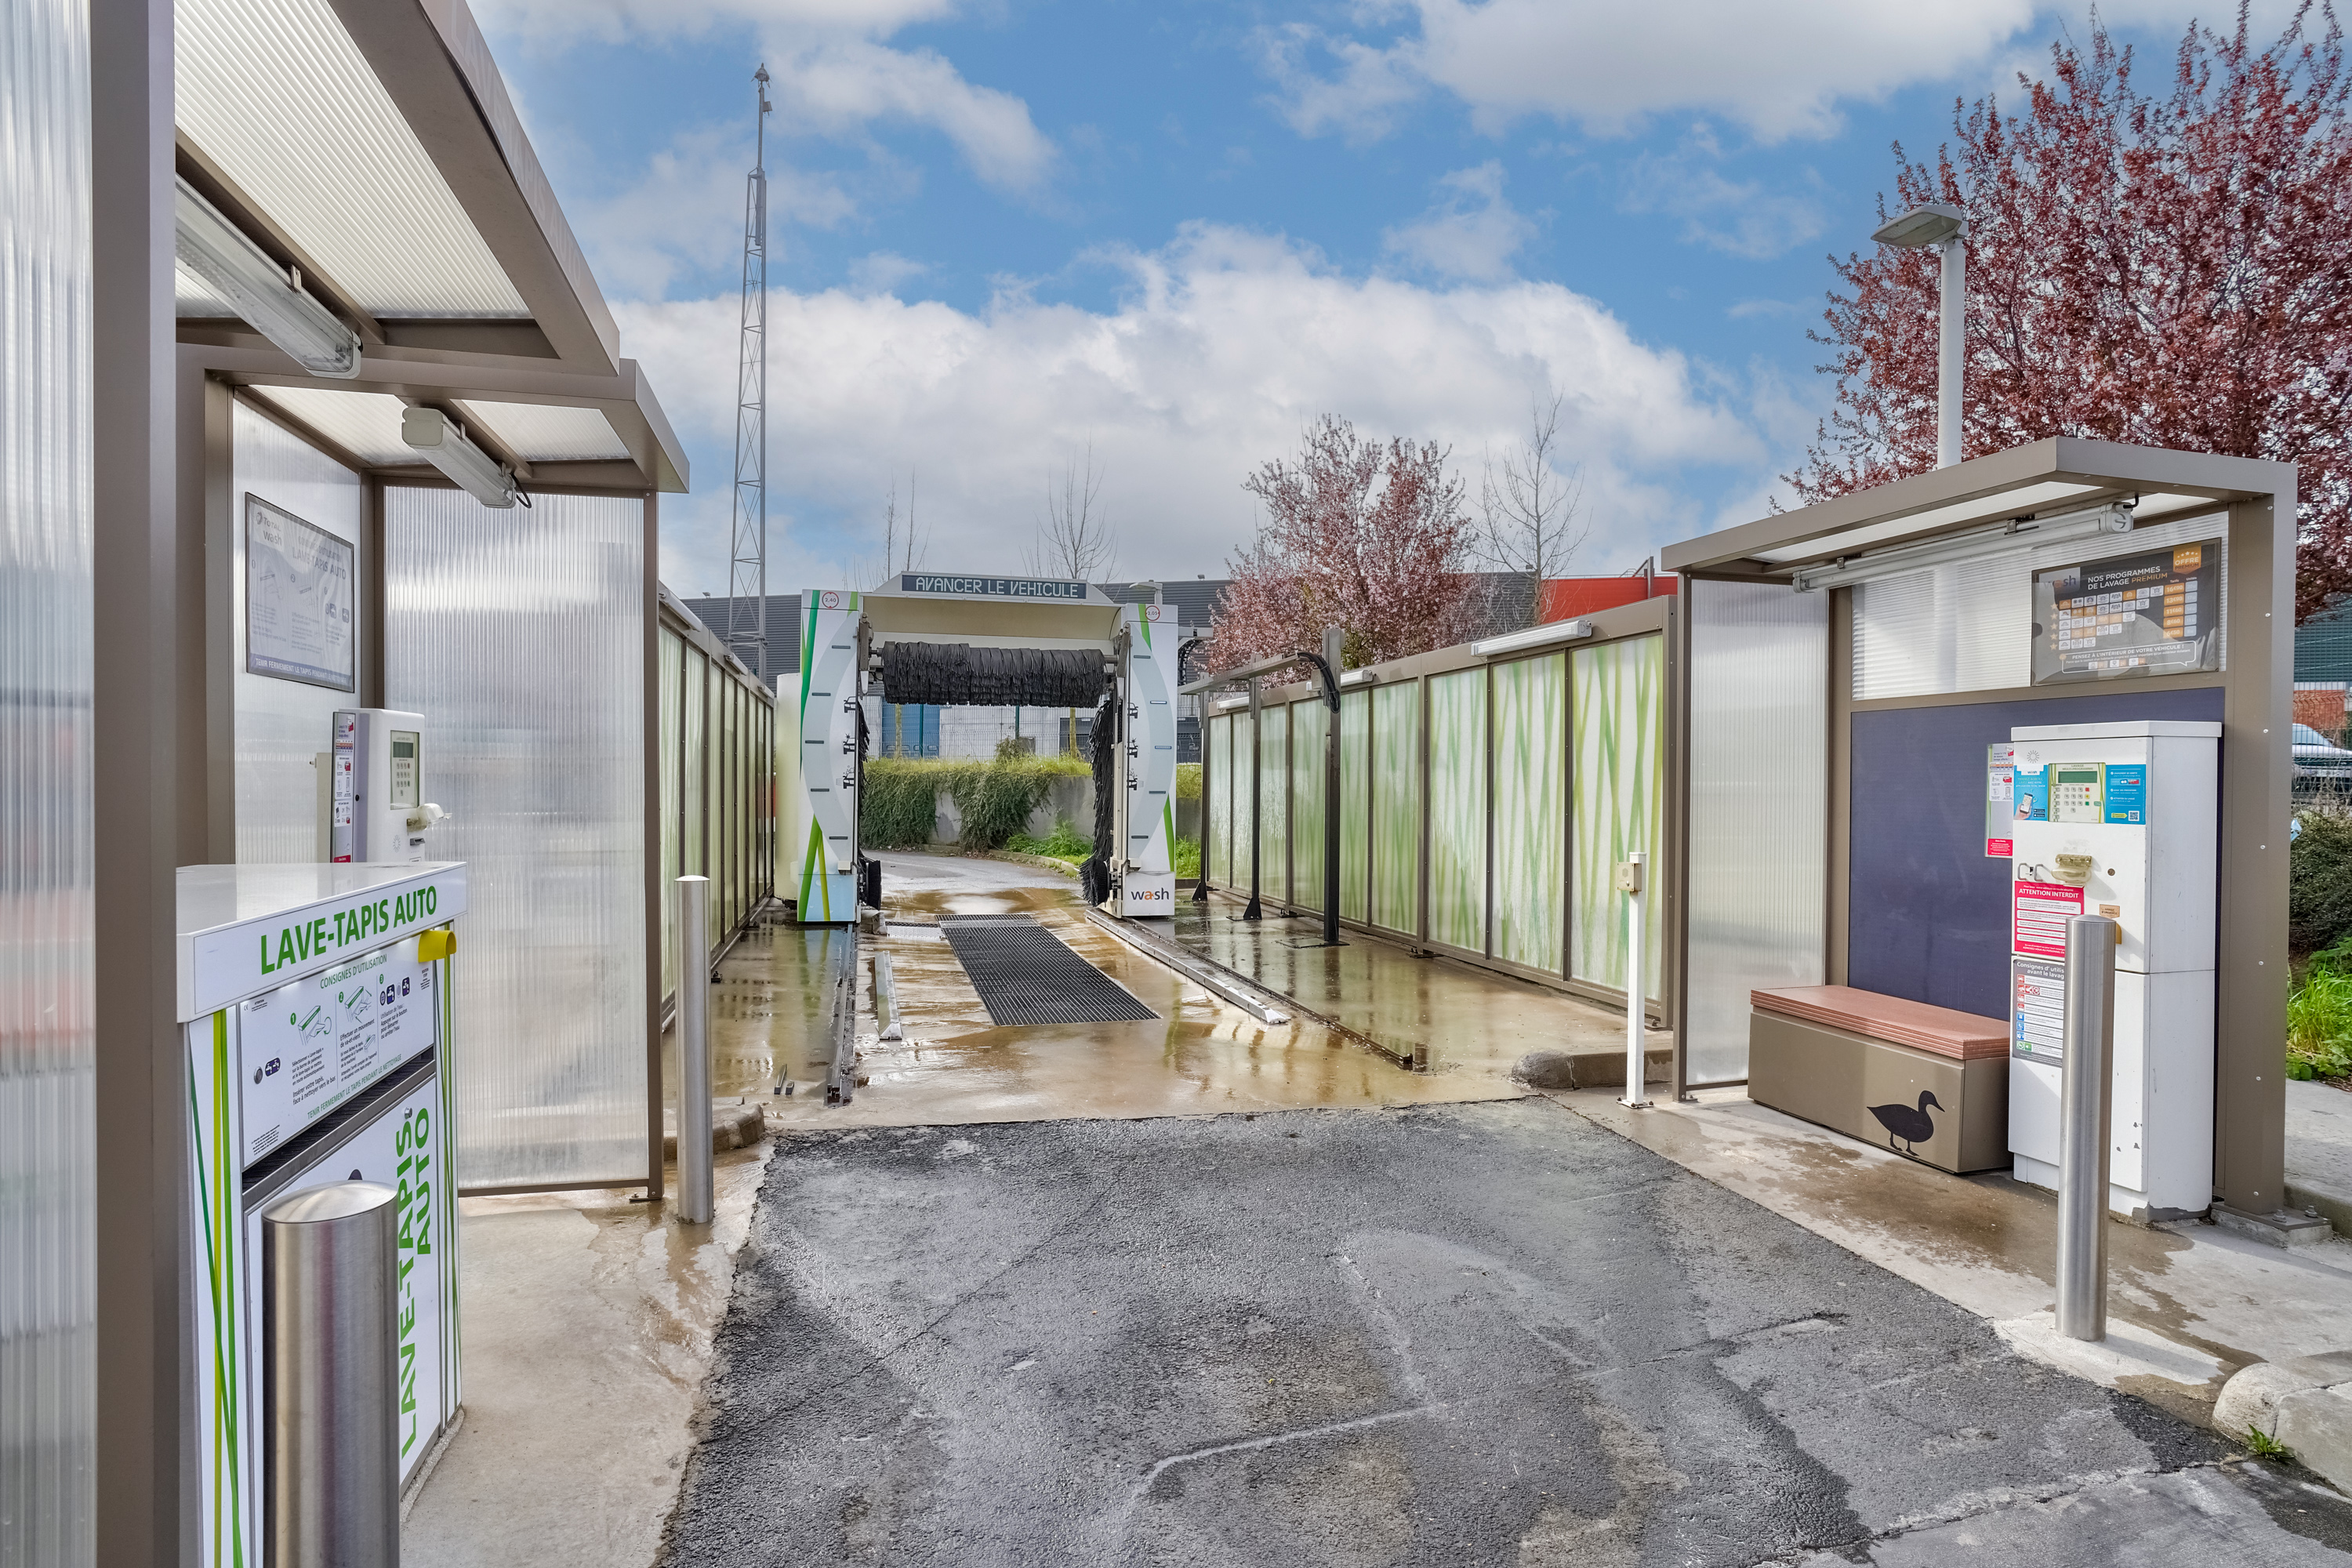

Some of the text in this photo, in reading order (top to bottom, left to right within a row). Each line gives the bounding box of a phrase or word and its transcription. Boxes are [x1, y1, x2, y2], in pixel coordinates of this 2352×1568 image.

[550, 201, 582, 289] AUTO
[263, 530, 282, 546] wash
[2175, 557, 2199, 565] OFFRE
[330, 564, 347, 580] AUTO
[2088, 565, 2161, 583] NOS PROGRAMMES
[2100, 578, 2129, 588] LAVAGE
[2132, 572, 2168, 583] PREMIUM
[916, 577, 1079, 597] AVANCER LE VEHICULE
[256, 658, 268, 668] TENIR
[268, 660, 294, 671] FERMEMENT
[1131, 887, 1170, 900] wash
[2019, 888, 2051, 897] ATTENTION
[260, 885, 437, 975] LAVE-TAPIS AUTO
[320, 953, 387, 989] CONSIGNES D'UTILISATION
[2016, 961, 2044, 970] Consignes
[2049, 971, 2064, 980] lavag
[293, 1087, 305, 1098] Insérer
[306, 1081, 314, 1091] votre
[304, 1087, 318, 1098] nettoyer
[307, 1106, 320, 1120] TENIR
[321, 1089, 346, 1112] FERMEMENT
[346, 1087, 350, 1095] LE
[350, 1080, 361, 1093] TAPIS
[361, 1069, 378, 1084] PENDANT
[383, 1054, 402, 1072] NETTOYAGE
[415, 1107, 431, 1254] AUTO
[396, 1120, 416, 1461] LAVE-TAPIS
